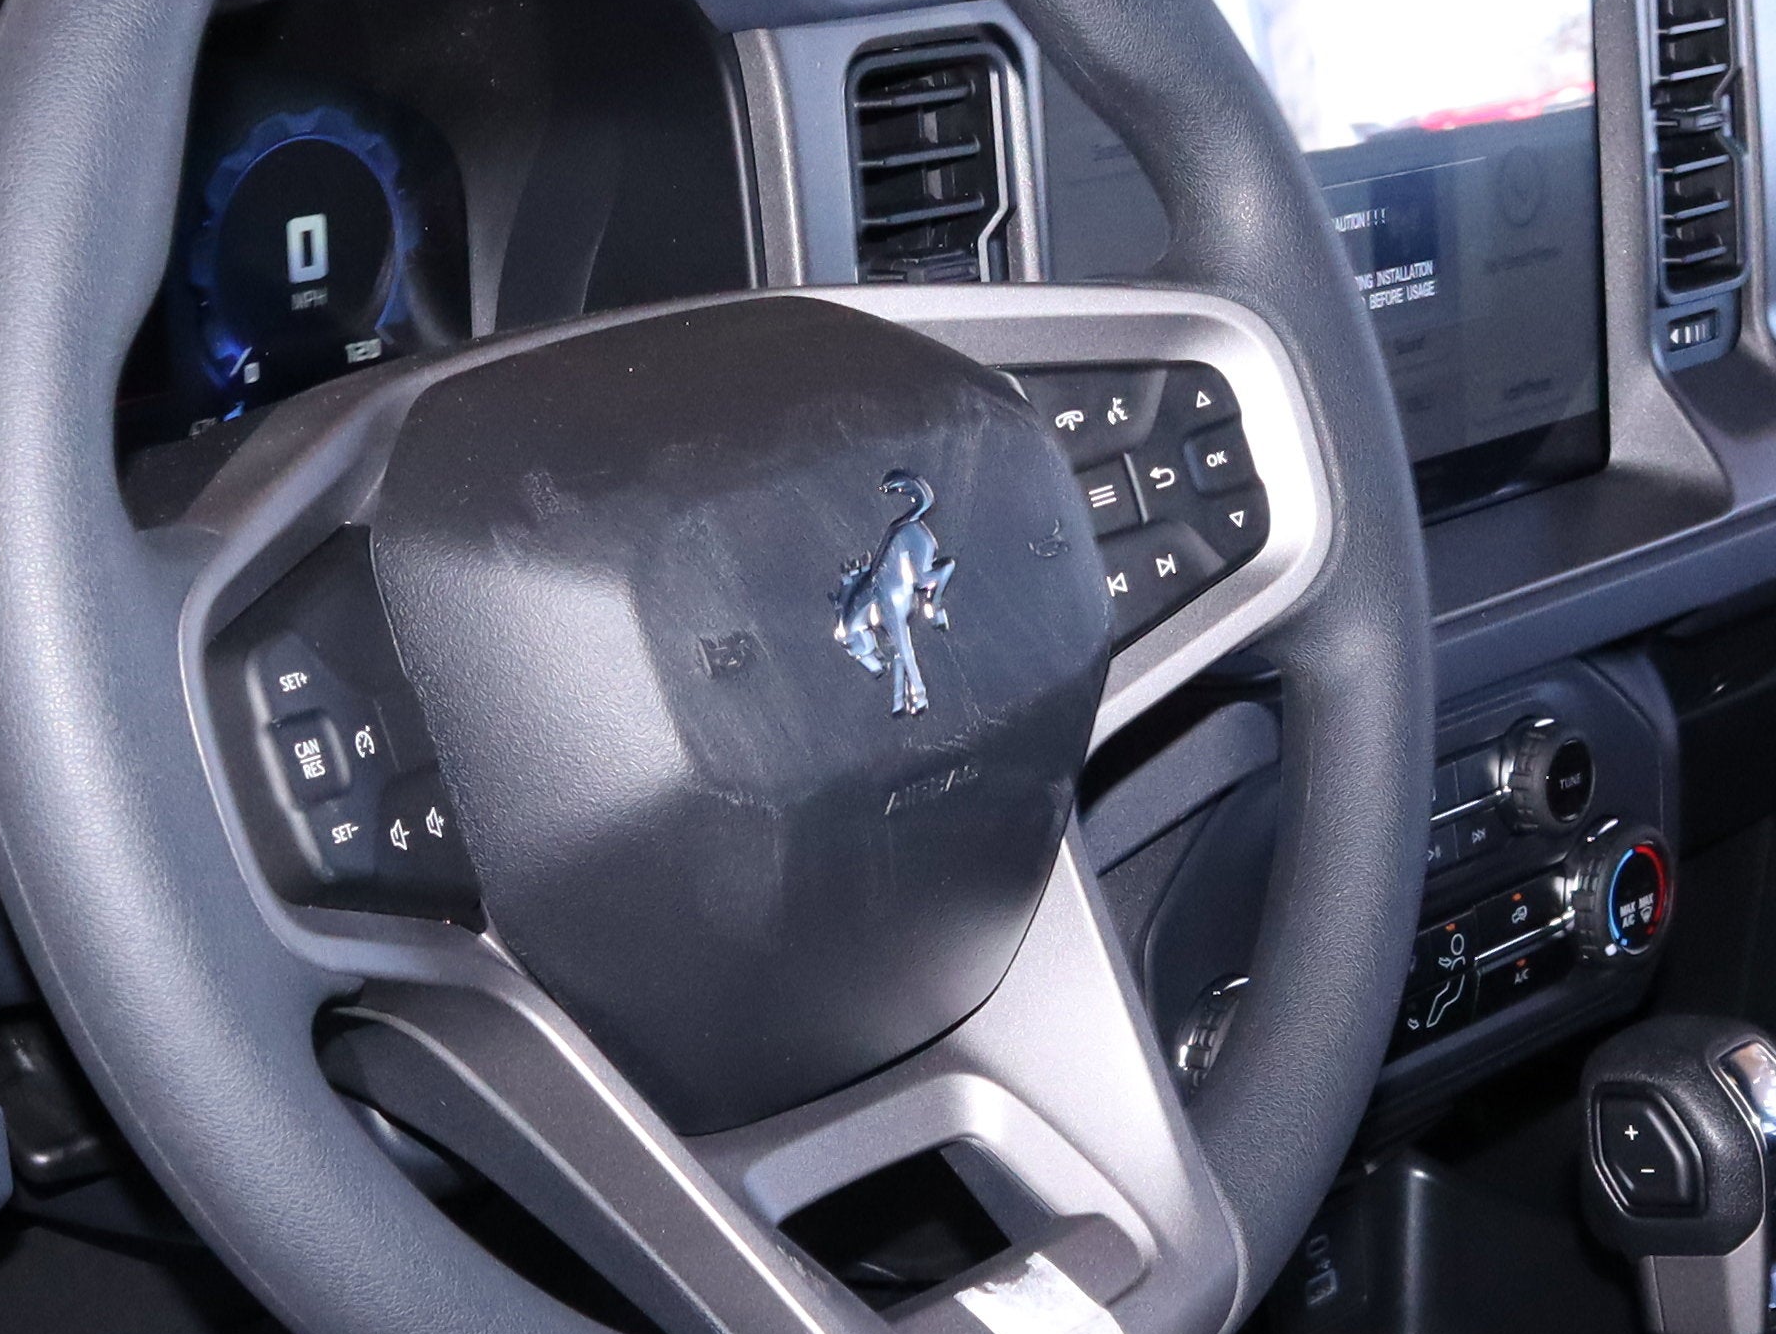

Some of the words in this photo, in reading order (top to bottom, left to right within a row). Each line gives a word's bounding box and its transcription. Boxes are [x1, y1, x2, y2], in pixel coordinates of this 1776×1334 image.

[286, 213, 328, 284] 0
[1376, 260, 1434, 287] INSTALLATION
[1369, 288, 1404, 310] BEFORE
[1406, 280, 1437, 301] USAGE
[1206, 450, 1227, 468] OK
[279, 672, 308, 693] SET+
[294, 738, 320, 759] CAN
[302, 760, 326, 780] RES
